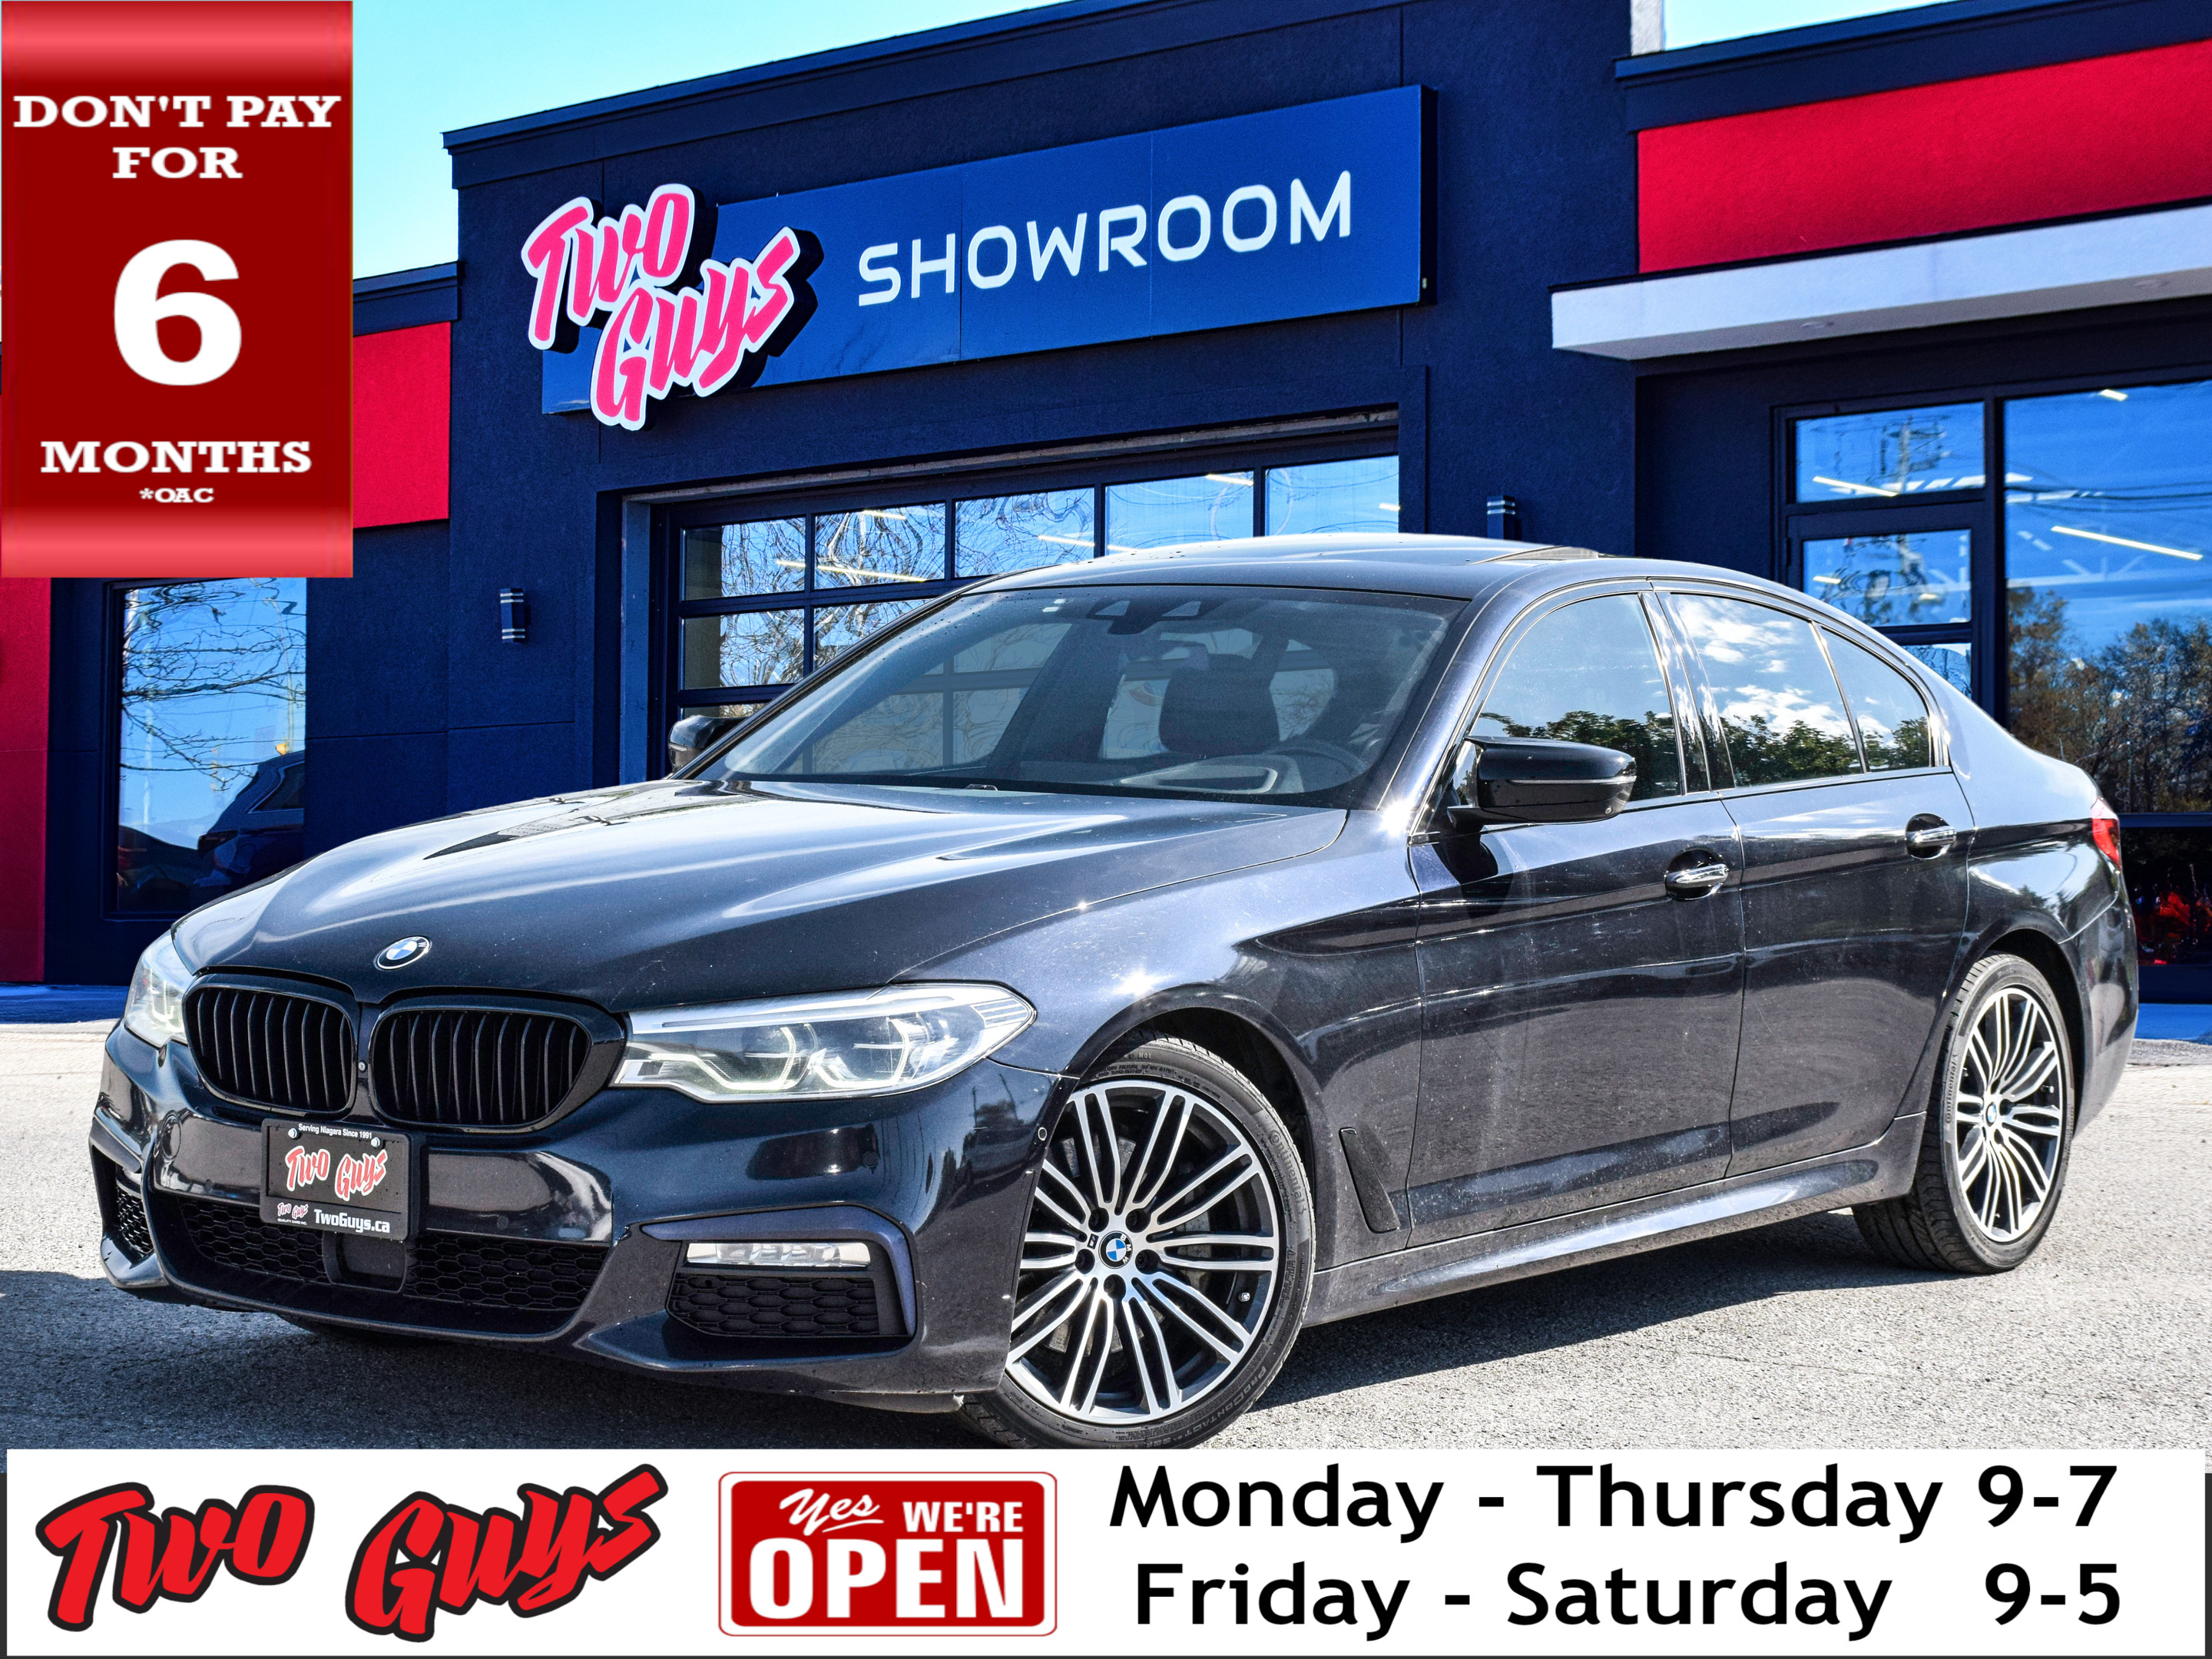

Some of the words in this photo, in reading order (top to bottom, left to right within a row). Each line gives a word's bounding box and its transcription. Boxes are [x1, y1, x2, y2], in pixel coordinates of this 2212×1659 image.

[859, 171, 1350, 306] SHOWROOM
[590, 227, 800, 431] Guys
[298, 1123, 320, 1134] Serving
[320, 1126, 342, 1136] Niagara
[343, 1128, 358, 1137] Since
[359, 1131, 373, 1140] 1991
[335, 1149, 388, 1201] Guys
[1270, 1130, 1305, 1203] Continental
[314, 1209, 390, 1233] TwoGuys.ca
[1121, 1233, 1131, 1264] BMW
